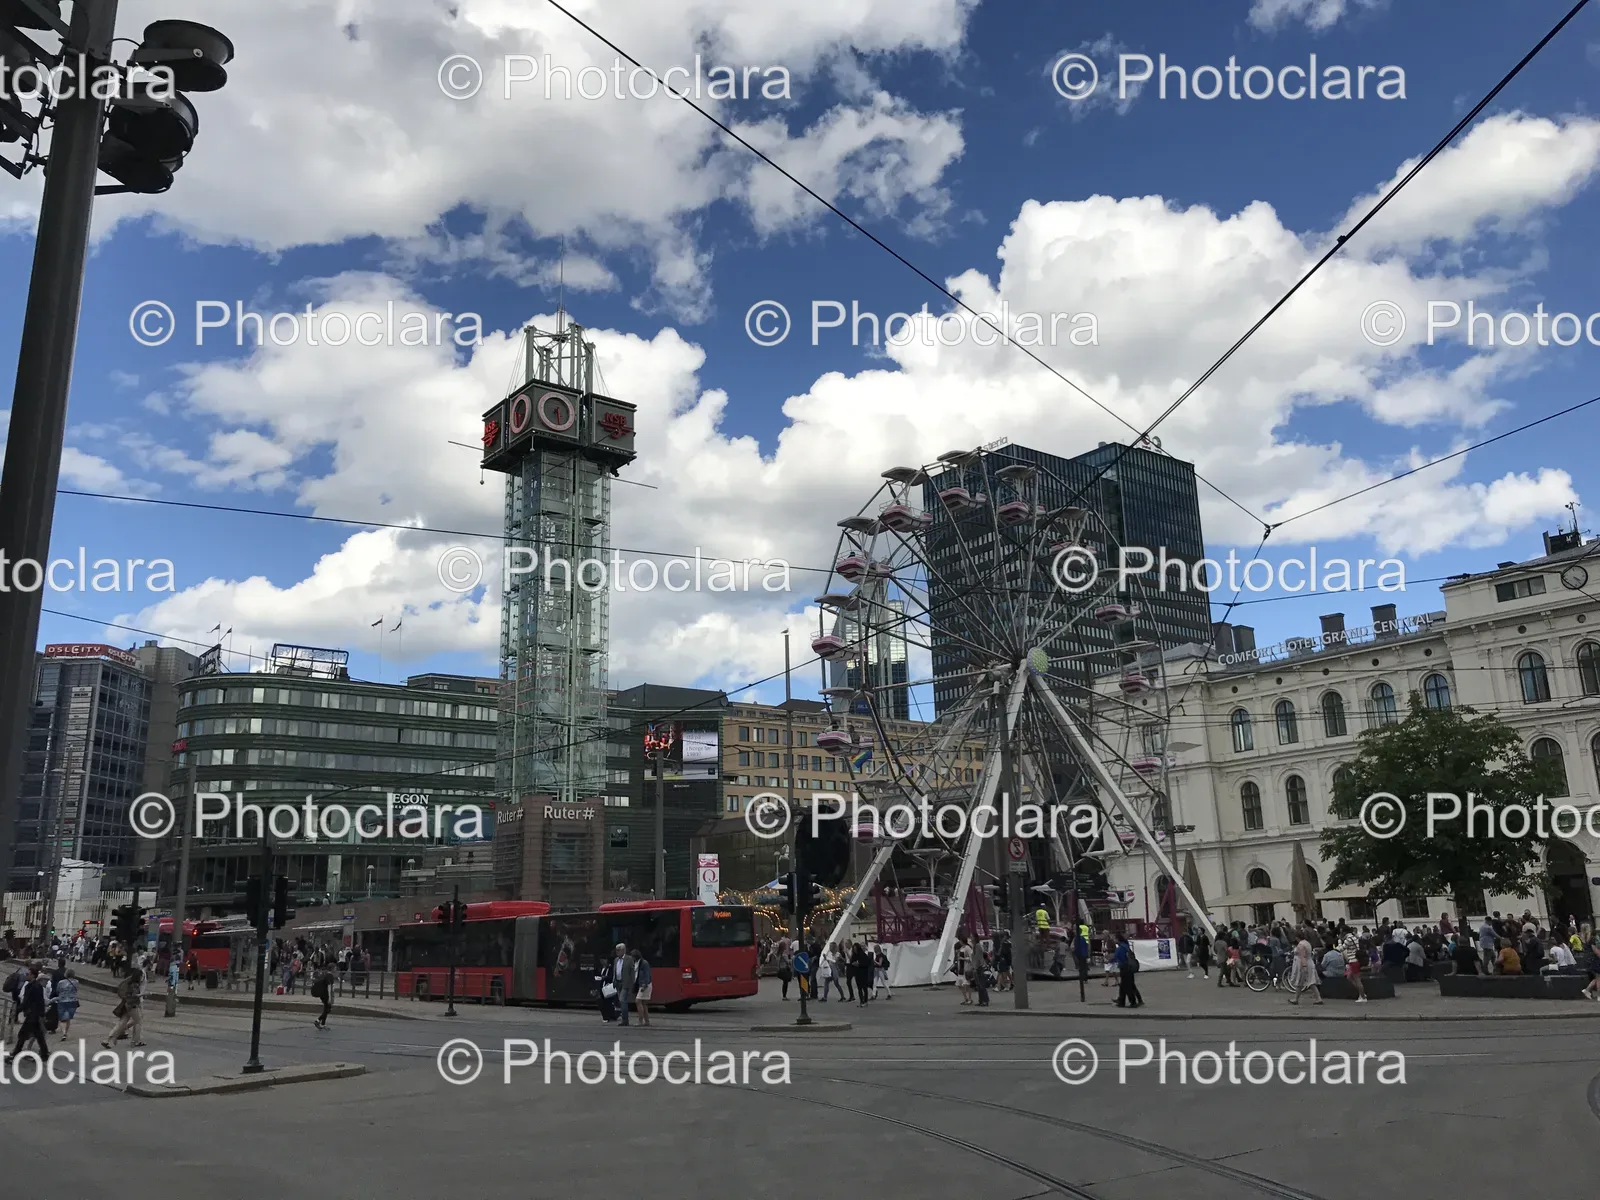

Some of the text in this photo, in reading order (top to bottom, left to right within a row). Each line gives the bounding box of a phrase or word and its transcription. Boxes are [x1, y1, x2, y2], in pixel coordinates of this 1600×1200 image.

[1218, 645, 1276, 666] COMFORT
[1278, 637, 1319, 653] HOTEL
[1321, 627, 1368, 645] GRAND
[393, 793, 430, 805] EGON
